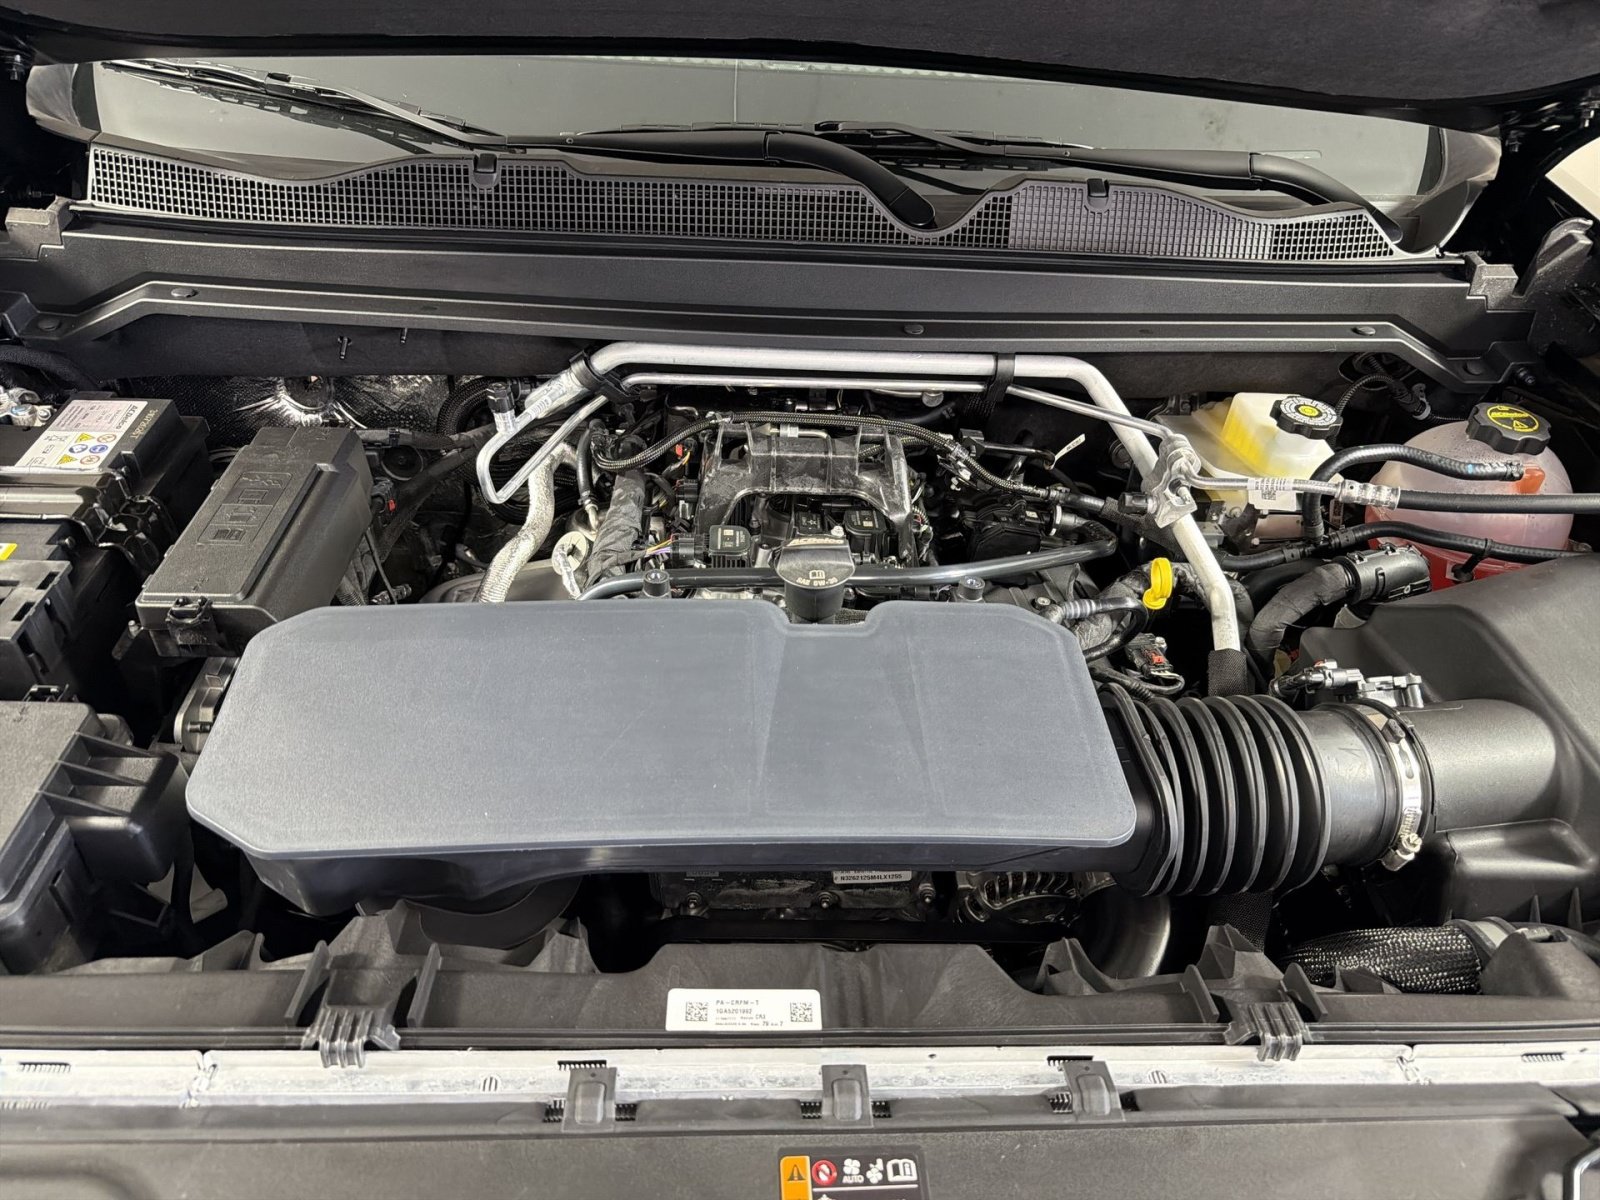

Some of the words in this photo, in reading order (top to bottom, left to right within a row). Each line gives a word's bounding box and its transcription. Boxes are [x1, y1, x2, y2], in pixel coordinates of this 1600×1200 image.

[116, 404, 139, 429] ACDelco
[788, 537, 845, 545] ACDelco
[842, 1174, 865, 1184] AUTO
